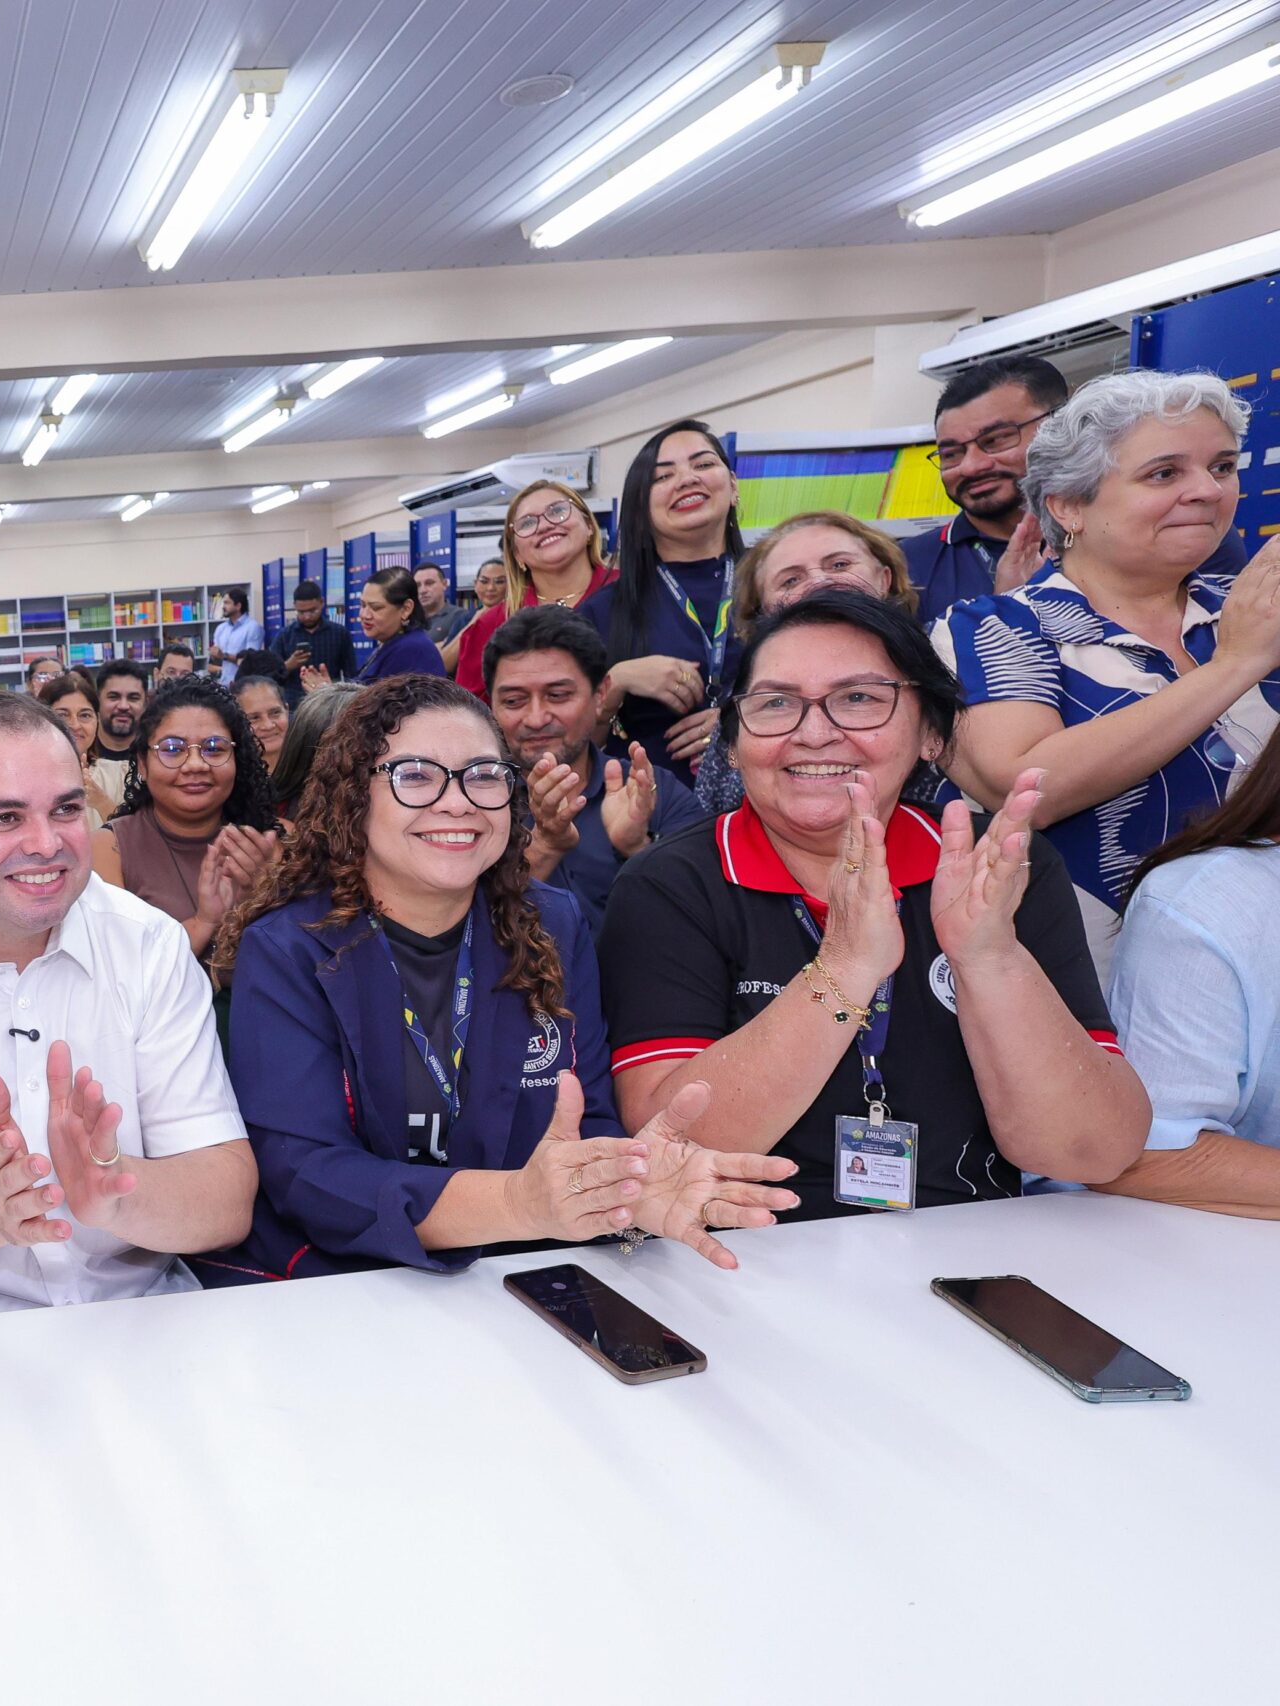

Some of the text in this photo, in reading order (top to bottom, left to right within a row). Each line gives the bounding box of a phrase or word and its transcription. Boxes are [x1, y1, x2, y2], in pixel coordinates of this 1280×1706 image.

[937, 963, 949, 984] CENTRO
[523, 1038, 558, 1070] SANTOS BRAGA
[865, 1130, 901, 1143] AMAZONAS
